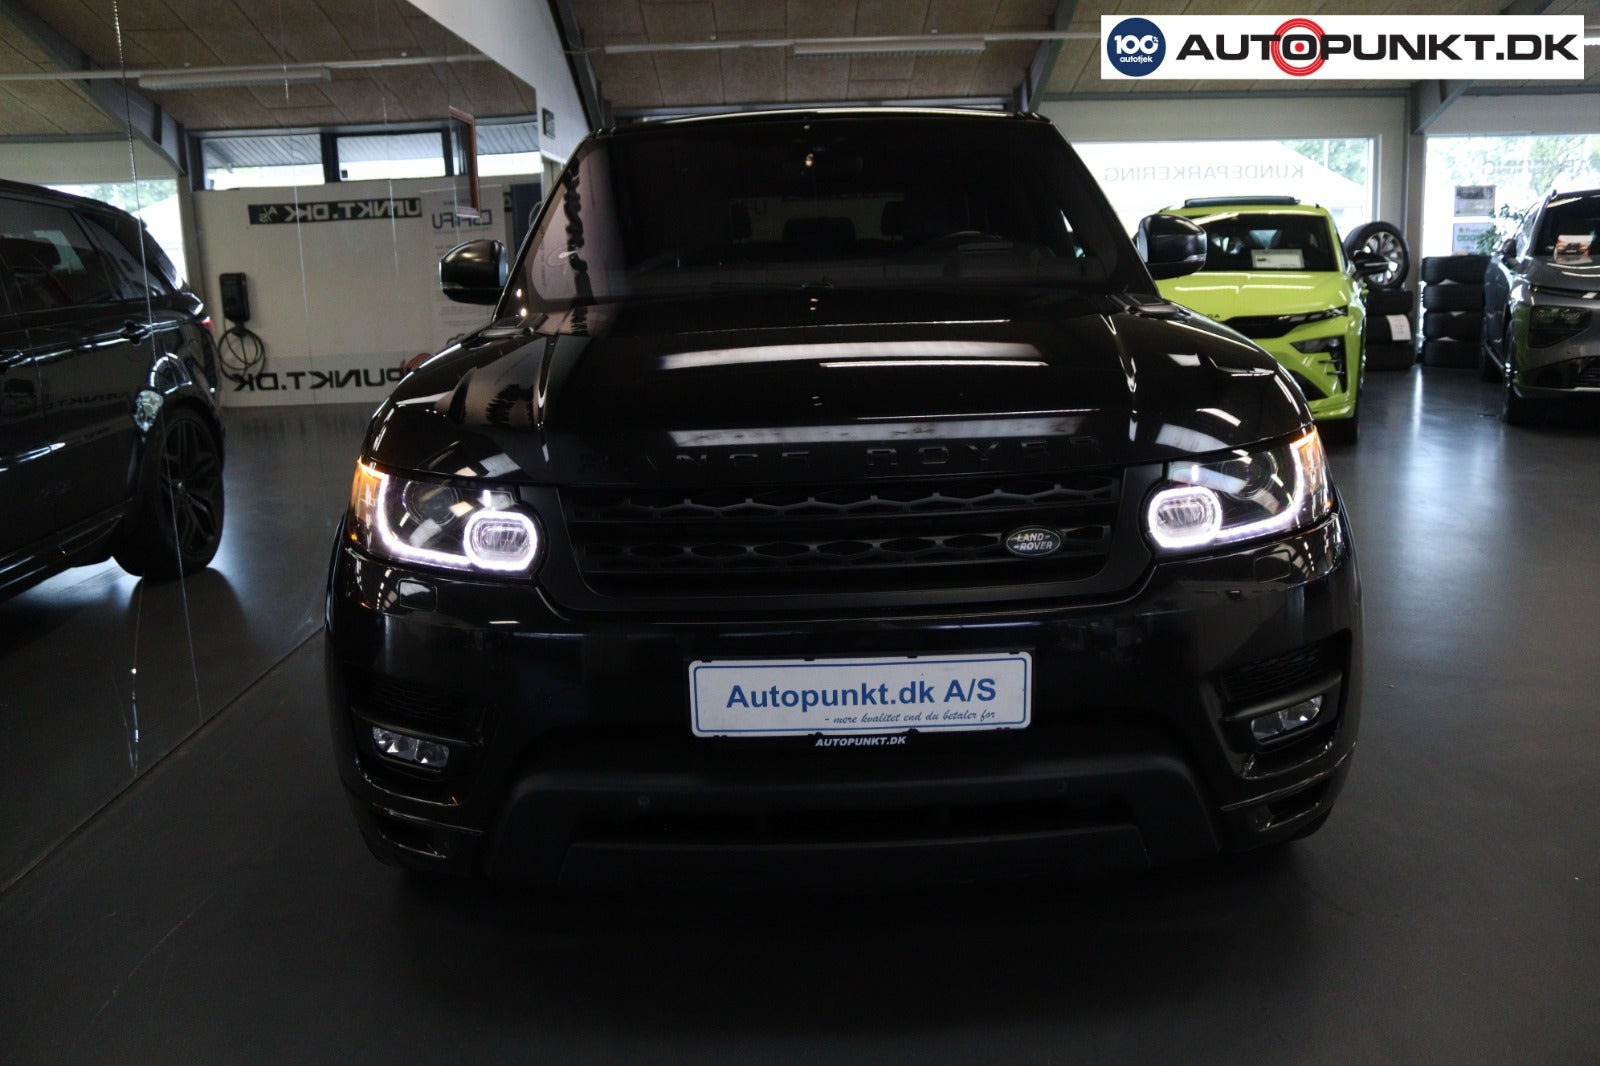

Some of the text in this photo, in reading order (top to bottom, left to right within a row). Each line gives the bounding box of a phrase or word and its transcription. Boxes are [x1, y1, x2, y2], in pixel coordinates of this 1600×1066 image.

[1017, 532, 1045, 542] LAND
[1019, 541, 1053, 551] ROVER
[726, 677, 998, 713] Autopunkt.dk A/S
[833, 715, 858, 724] mere
[861, 712, 901, 723] kvalitet
[903, 712, 923, 722] end
[925, 711, 939, 721] du
[943, 709, 977, 720] betaler
[980, 708, 996, 723] for
[815, 736, 907, 747] AUTOPUNKT.DK
